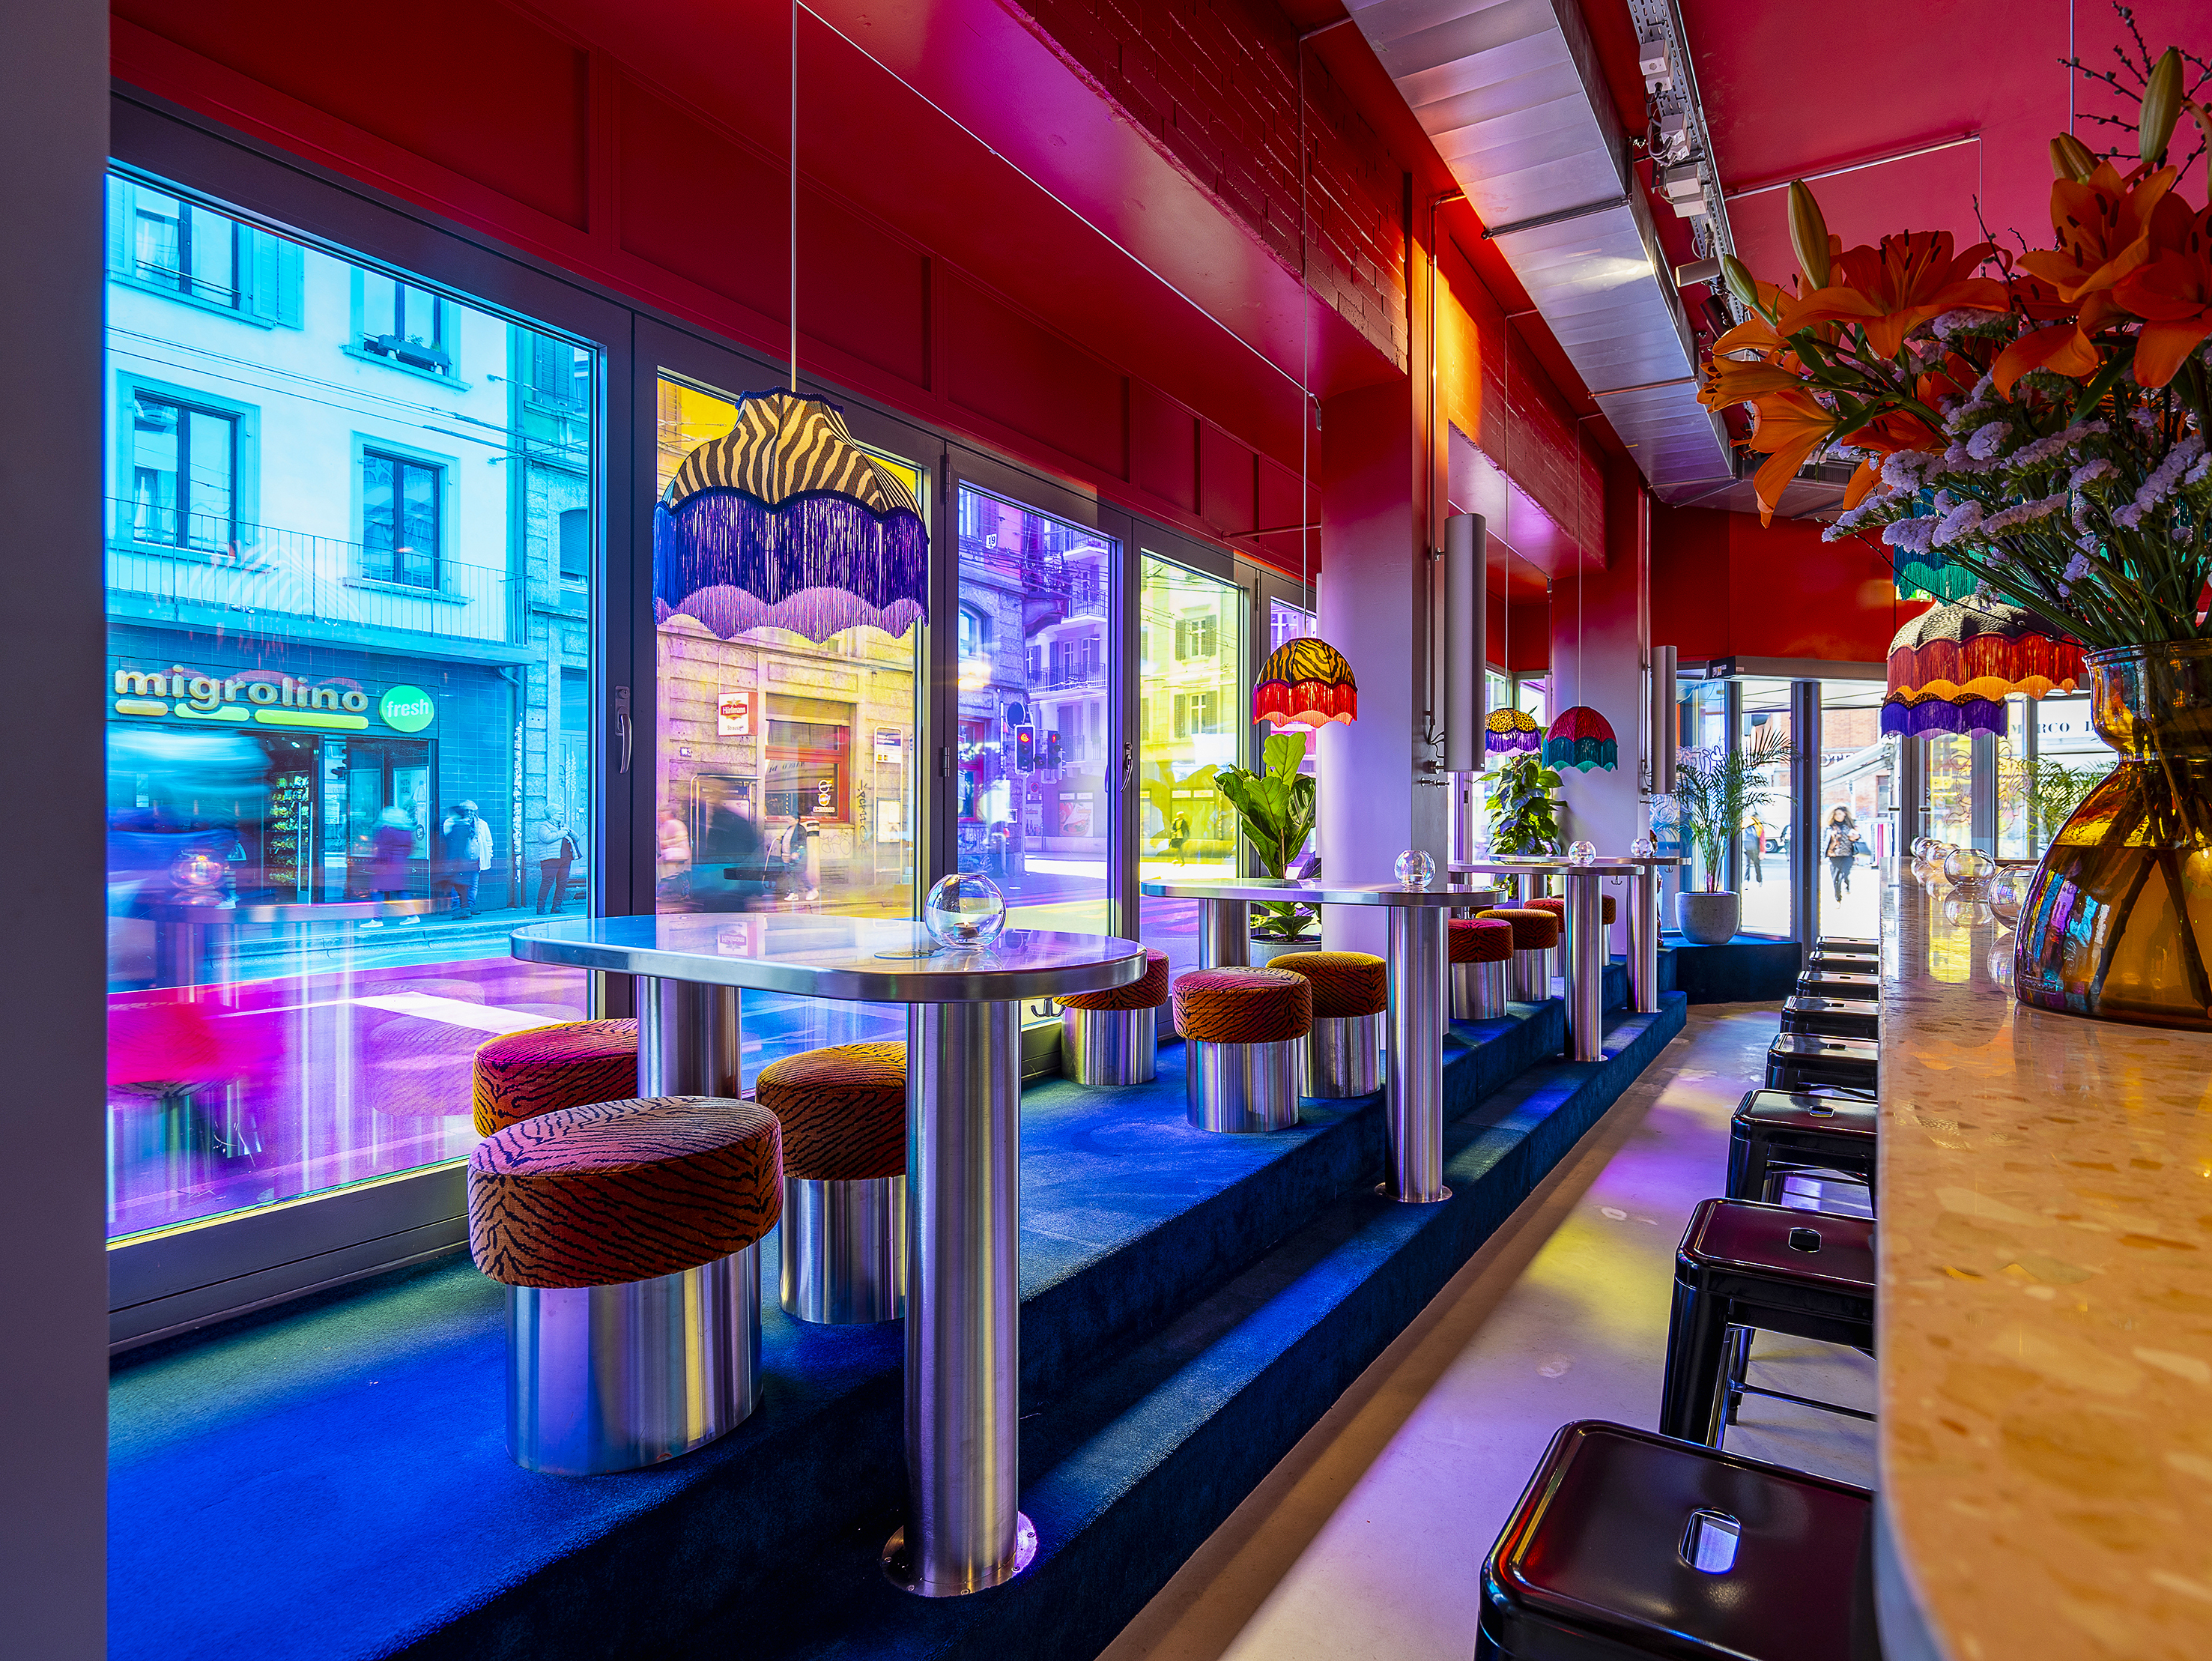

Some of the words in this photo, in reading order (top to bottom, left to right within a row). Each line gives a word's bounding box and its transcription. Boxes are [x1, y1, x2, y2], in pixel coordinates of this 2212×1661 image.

[988, 536, 996, 545] 19
[115, 664, 369, 712] migrolino
[387, 699, 429, 718] fresh
[2011, 721, 2070, 734] MRCO
